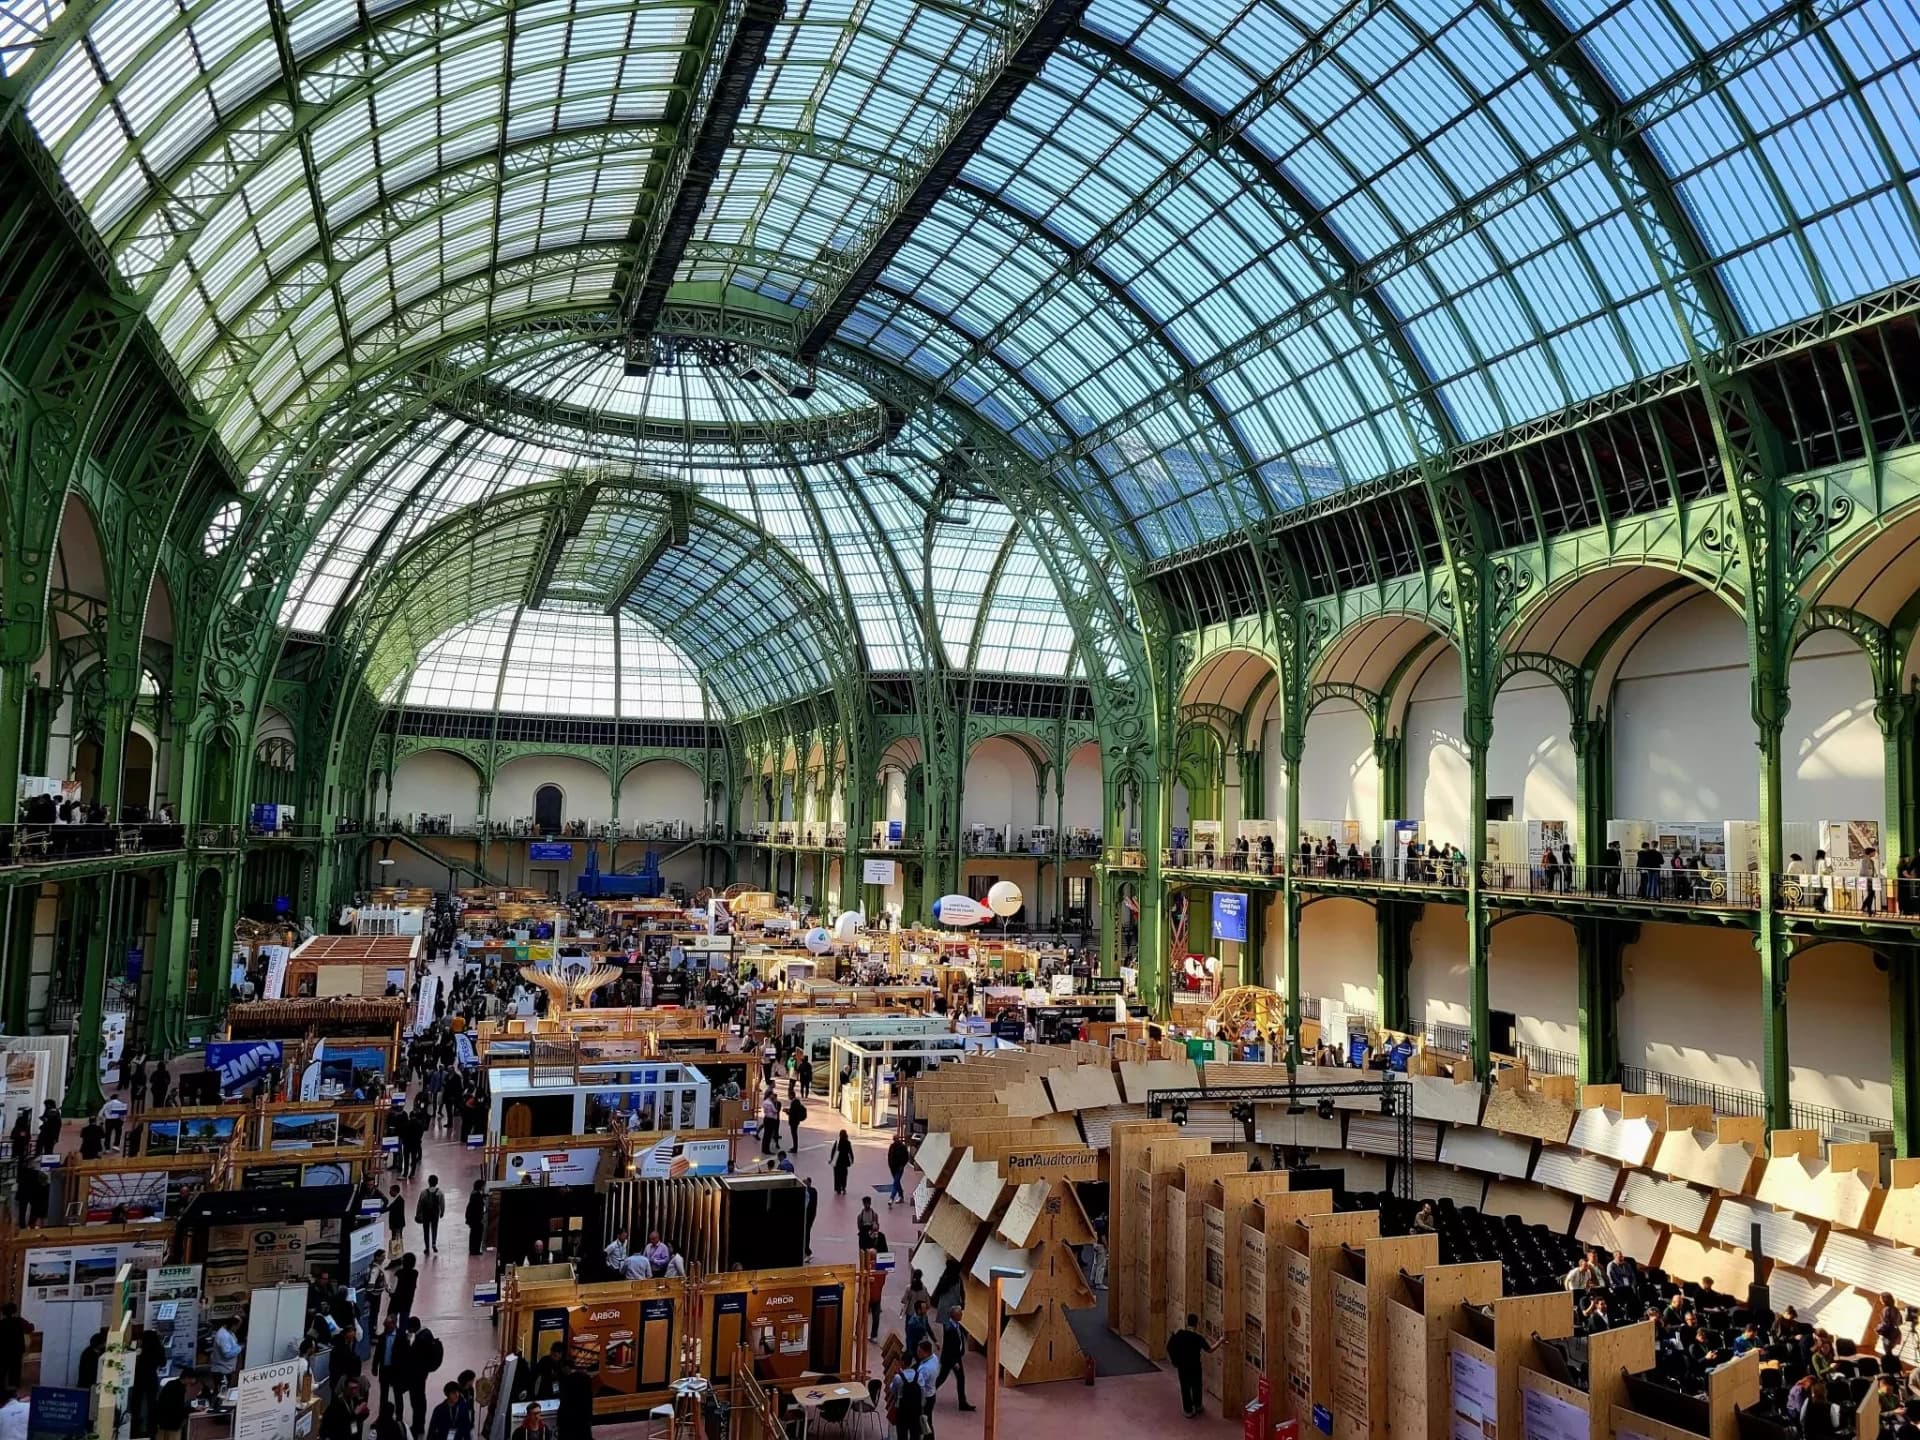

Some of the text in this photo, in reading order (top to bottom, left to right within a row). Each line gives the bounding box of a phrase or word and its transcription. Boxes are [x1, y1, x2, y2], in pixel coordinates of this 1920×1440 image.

[1008, 1151, 1098, 1169] Pan'Auditorium
[766, 1296, 794, 1306] ARBOR
[589, 1311, 620, 1321] ARBOR
